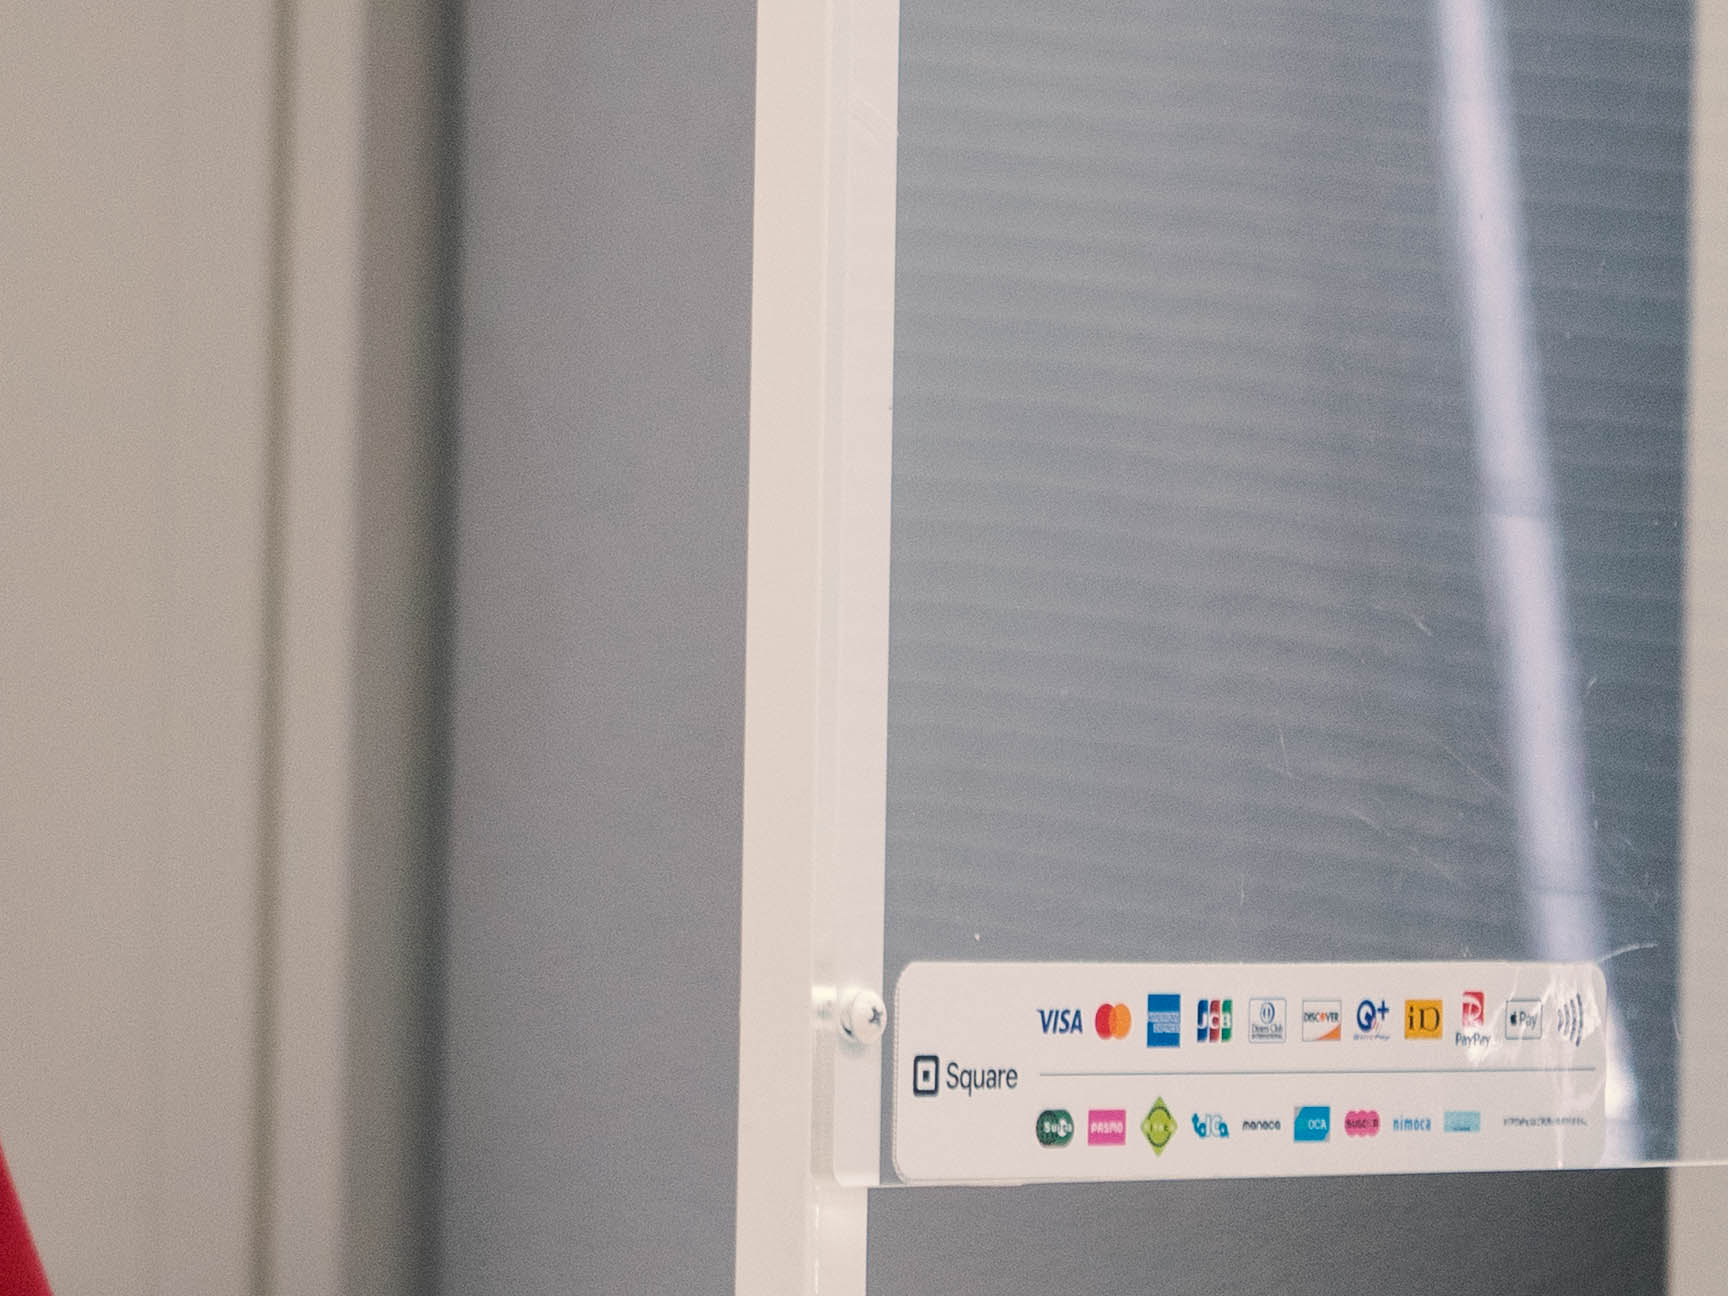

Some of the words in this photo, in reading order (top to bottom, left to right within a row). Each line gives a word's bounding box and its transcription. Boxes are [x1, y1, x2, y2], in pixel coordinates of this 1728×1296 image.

[1038, 1008, 1084, 1034] VISA
[1303, 1009, 1340, 1024] DISCOVER
[1408, 1005, 1440, 1032] iD
[1519, 1012, 1537, 1028] Pay
[1455, 1031, 1491, 1048] PayPay
[946, 1061, 1018, 1098] Square
[1393, 1117, 1432, 1131] nimoca
